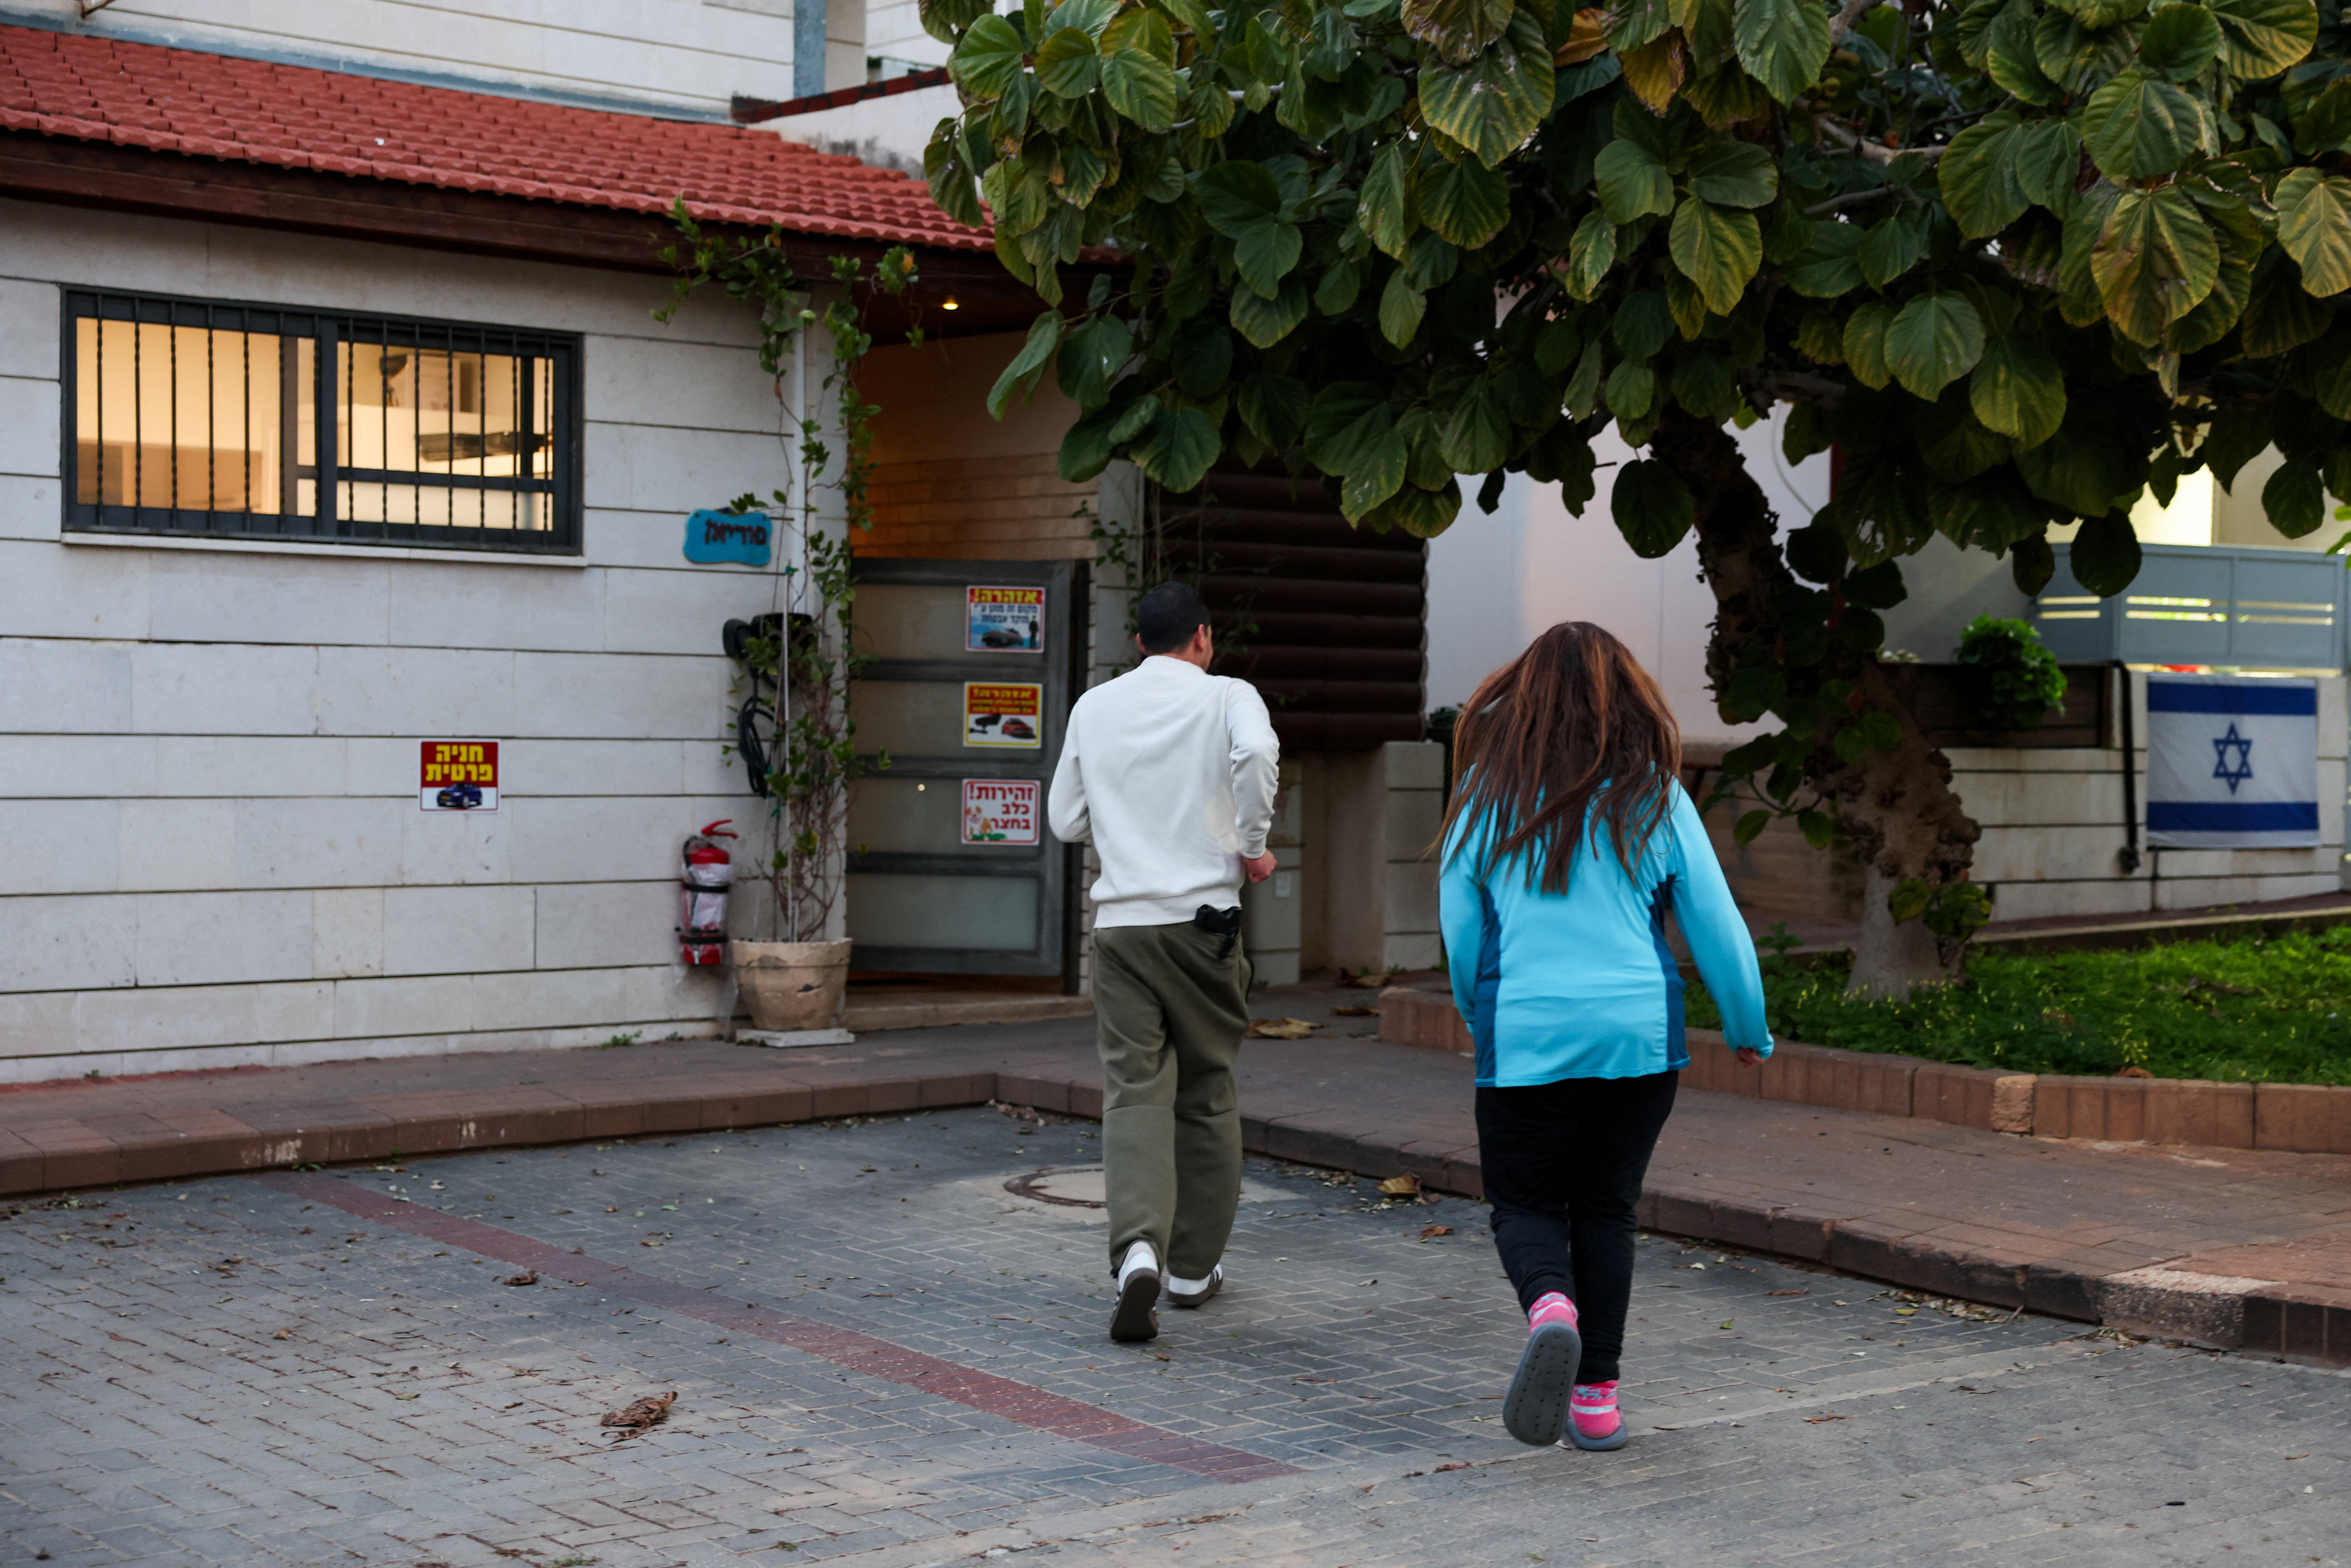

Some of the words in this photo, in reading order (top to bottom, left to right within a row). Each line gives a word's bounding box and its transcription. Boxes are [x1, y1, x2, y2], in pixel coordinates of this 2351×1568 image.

[974, 589, 1037, 603] אזהרה!
[436, 745, 483, 762] חניה
[426, 763, 493, 781] פרטית
[970, 784, 1033, 800] זהירות!
[1002, 802, 1029, 814] כלב
[991, 818, 1031, 829] בחצר
